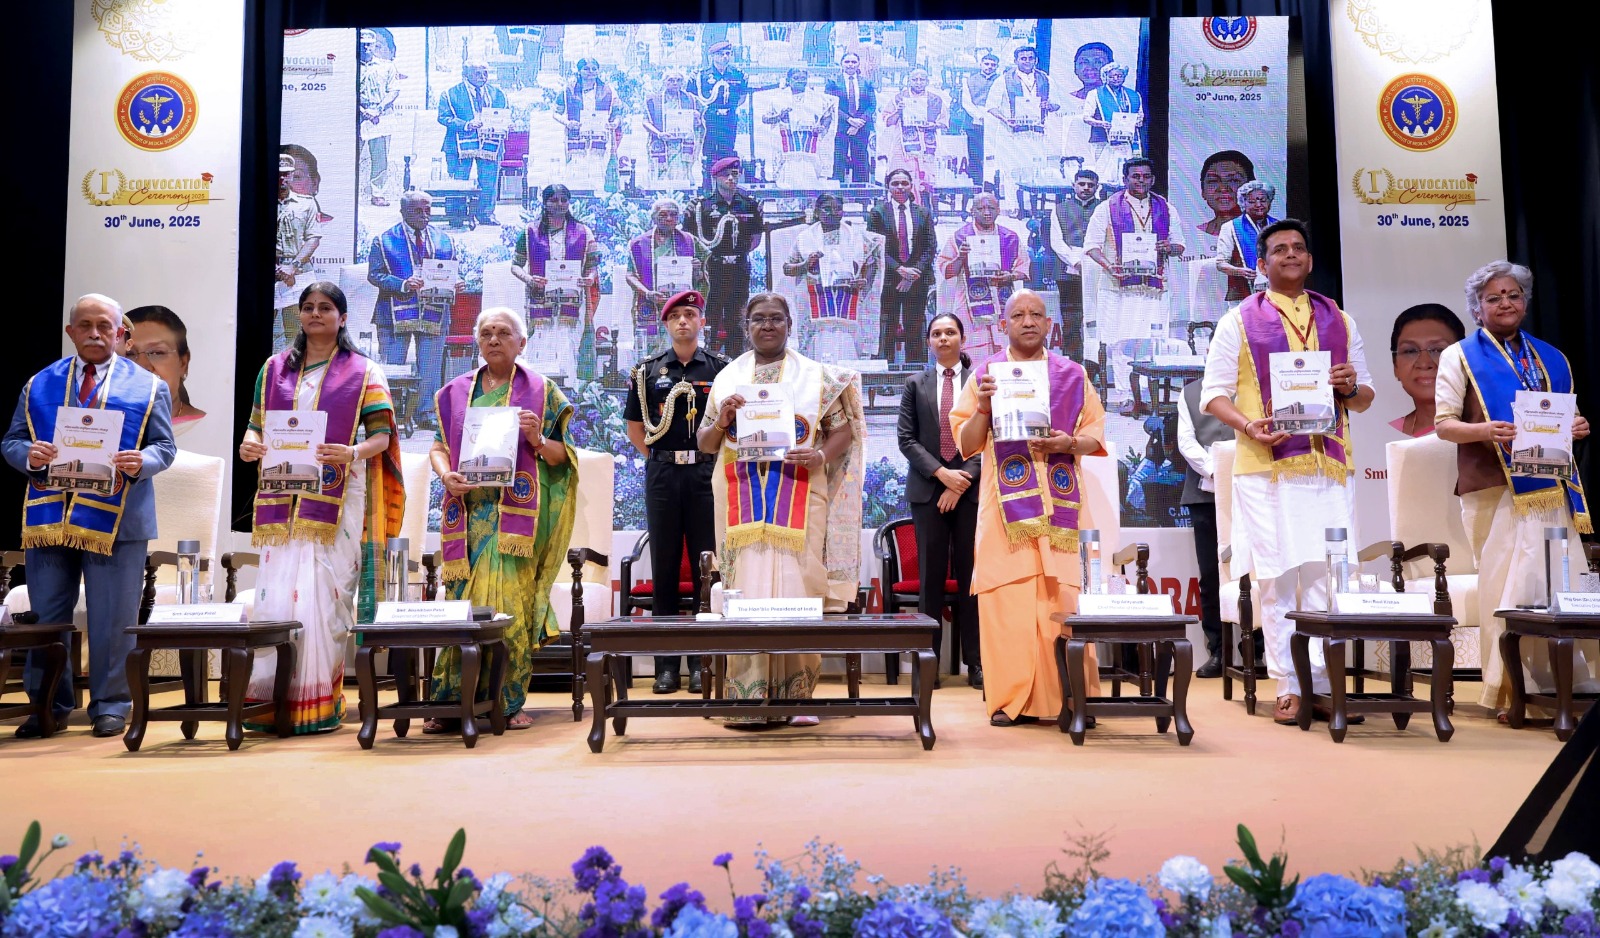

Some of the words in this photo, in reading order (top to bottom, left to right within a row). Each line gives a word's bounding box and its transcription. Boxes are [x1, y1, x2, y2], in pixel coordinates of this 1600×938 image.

[1212, 93, 1237, 102] June,
[128, 179, 210, 190] CONVOCATION
[1398, 179, 1474, 190] CONVOCATION
[104, 215, 127, 228] 30th
[128, 216, 165, 229] June,
[169, 216, 200, 227] 2025
[1377, 213, 1398, 226] 30th
[1401, 215, 1435, 228] June,
[1439, 216, 1469, 226] 2025
